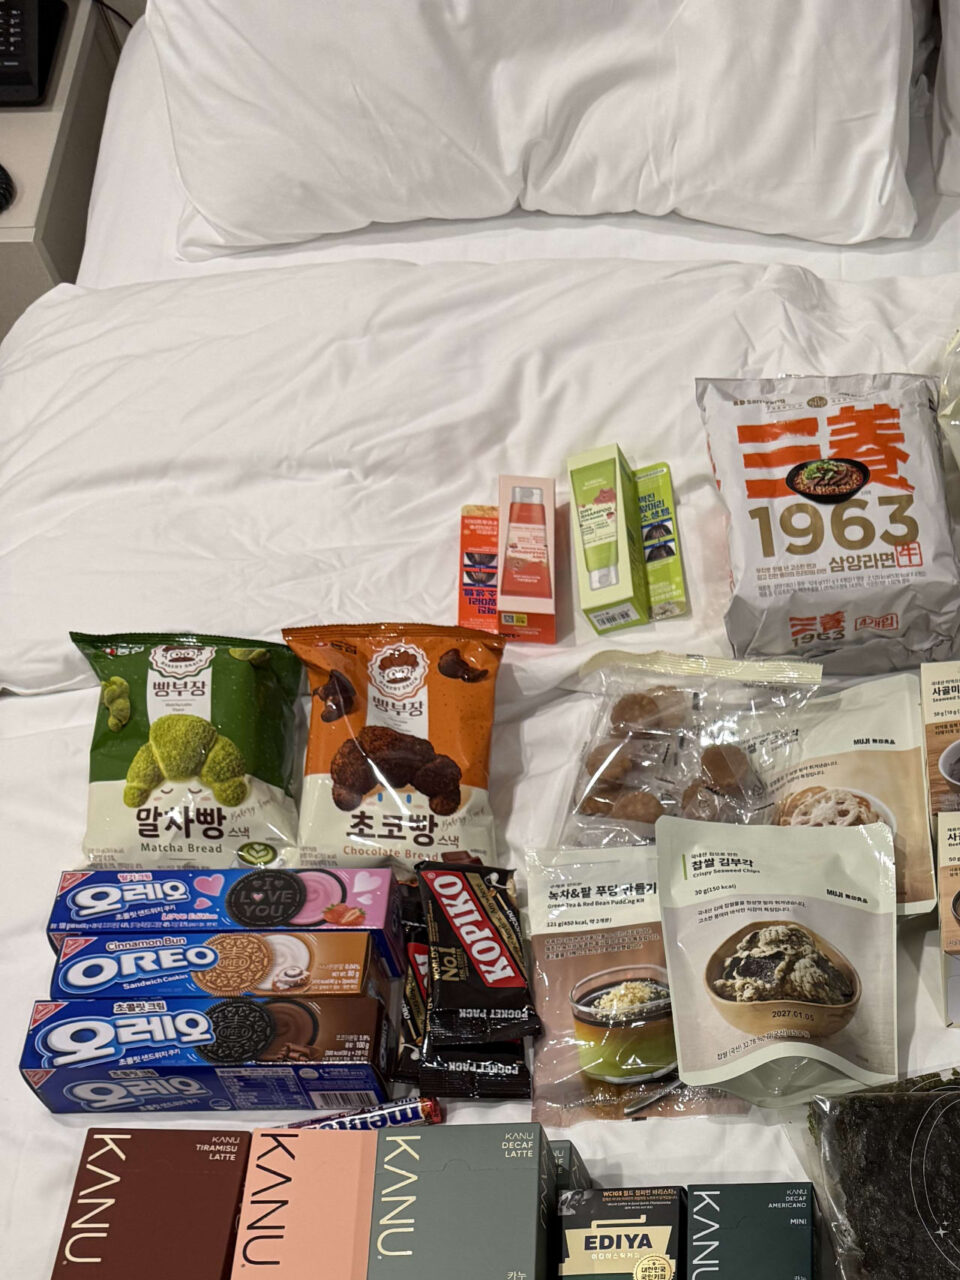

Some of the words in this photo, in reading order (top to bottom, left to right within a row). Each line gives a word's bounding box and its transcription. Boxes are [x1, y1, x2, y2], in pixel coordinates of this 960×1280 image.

[748, 494, 920, 558] 1963
[829, 554, 896, 572] 삼양라면
[140, 842, 183, 853] Matcha
[188, 843, 223, 853] Bread
[343, 845, 401, 857] Chocolate
[405, 850, 438, 861] Bread
[719, 857, 753, 867] 김부각
[693, 870, 712, 878] Crispy
[595, 884, 618, 897] 푸딩
[826, 889, 843, 897] MUJI
[74, 881, 191, 916] 오레오
[243, 903, 284, 917] YOU
[434, 874, 516, 984] KOPIKO
[107, 938, 161, 951] Cinnamon
[163, 937, 186, 946] Bun
[67, 946, 215, 986] OREO
[123, 977, 163, 990] Sandwich
[459, 1008, 486, 1018] PACK
[489, 1009, 529, 1019] POCKET
[772, 1010, 814, 1021] 2027.01.05
[47, 1012, 211, 1066] 오레오
[195, 1144, 238, 1153] TIRAMISU
[502, 1141, 533, 1149] DECAF
[209, 1153, 236, 1161] LATTE
[505, 1150, 534, 1158] LATTE
[64, 1134, 132, 1263] KANU
[242, 1133, 299, 1265] KANU
[377, 1135, 422, 1256] KANU
[584, 1234, 653, 1251] EDIYA
[507, 1271, 527, 1280] 카누
